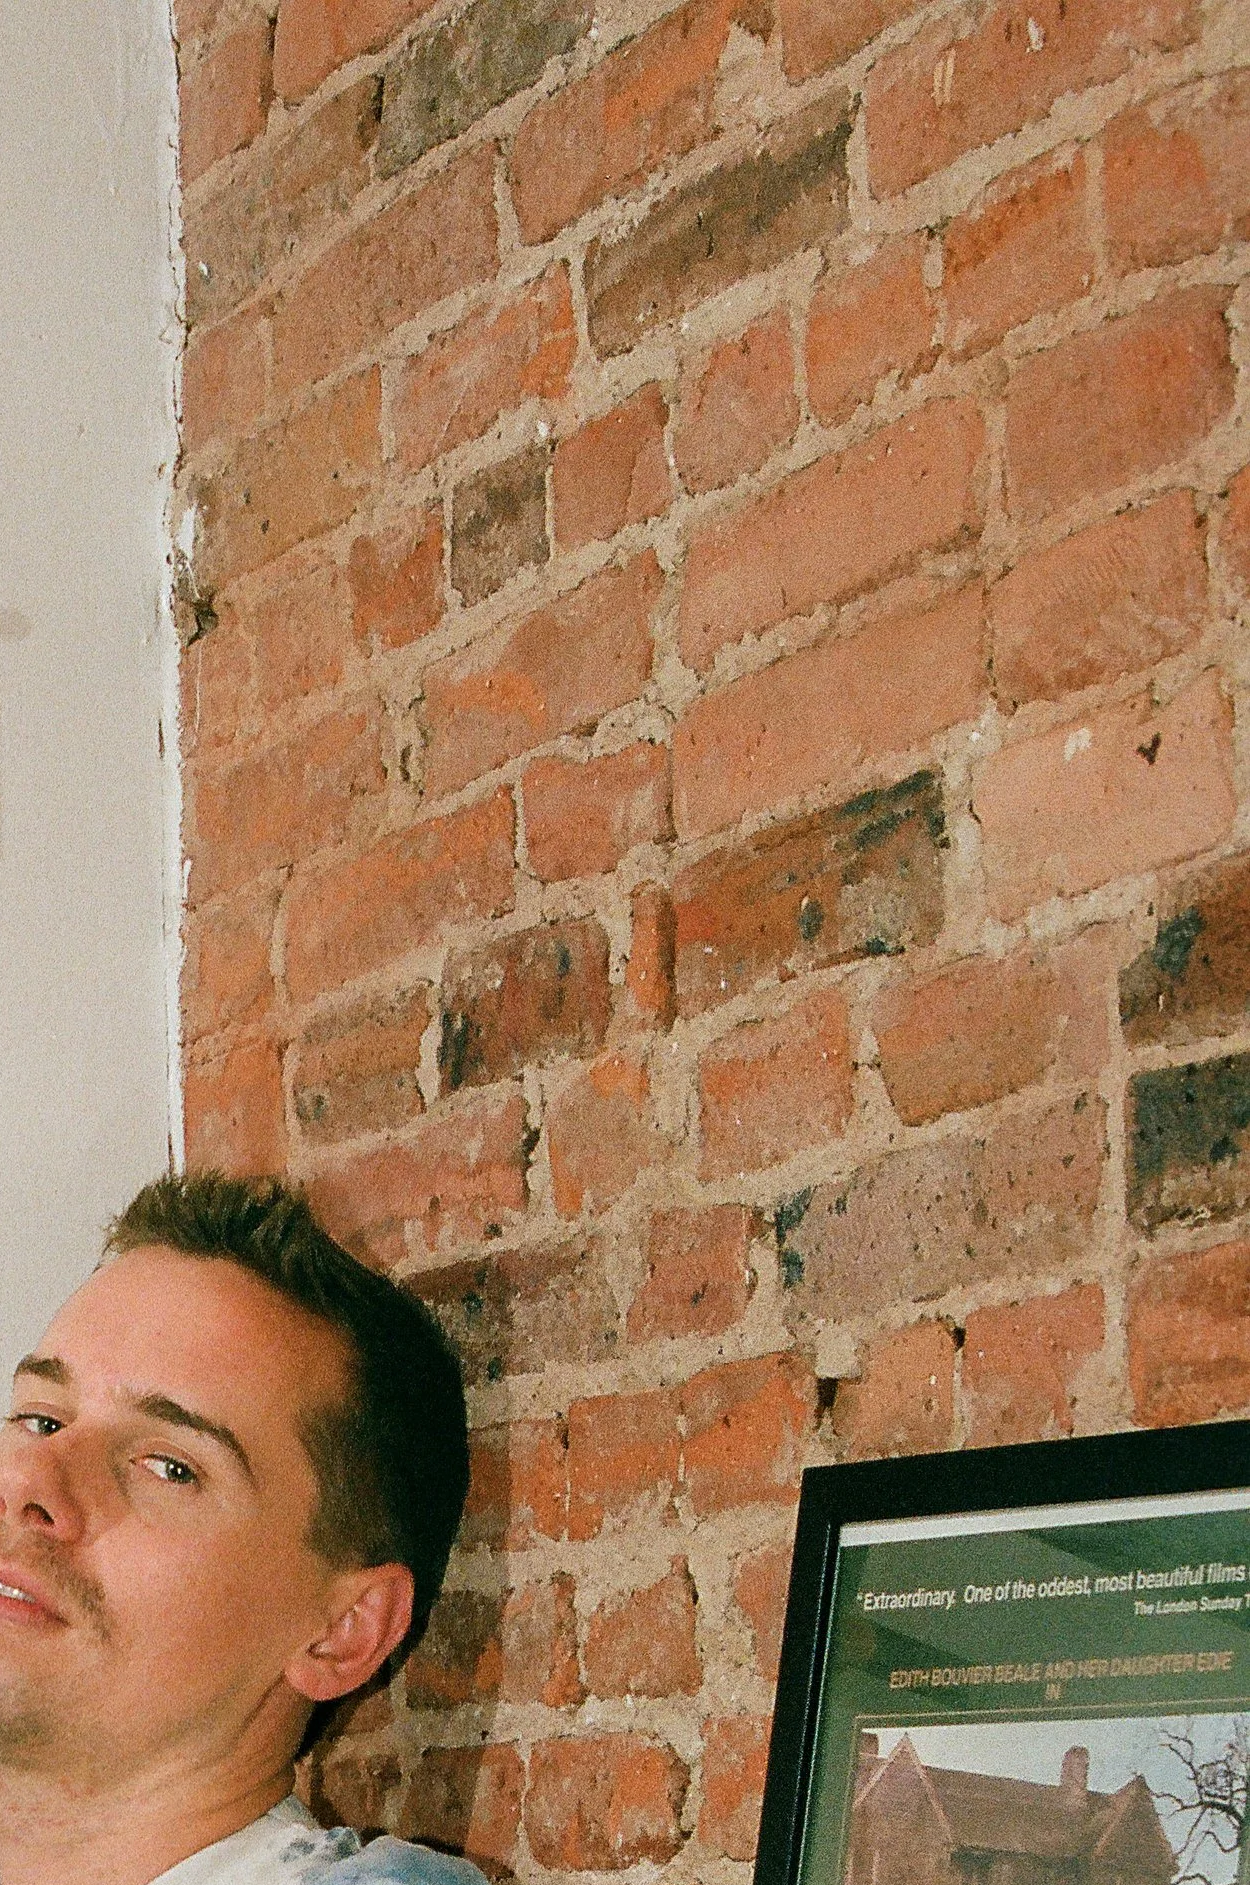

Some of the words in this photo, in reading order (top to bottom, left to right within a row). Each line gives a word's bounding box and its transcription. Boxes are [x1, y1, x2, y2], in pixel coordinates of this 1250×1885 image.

[963, 1584, 992, 1604] One
[994, 1581, 1011, 1602] of
[1012, 1579, 1036, 1600] the
[1037, 1578, 1092, 1599] oddest,
[1094, 1573, 1133, 1594] most
[1135, 1563, 1205, 1590] beautiful
[1206, 1562, 1247, 1584] films
[1134, 1600, 1154, 1617] The
[888, 1670, 931, 1690] EDITH
[931, 1665, 993, 1687] BOUVIER
[993, 1663, 1041, 1684] BEALE
